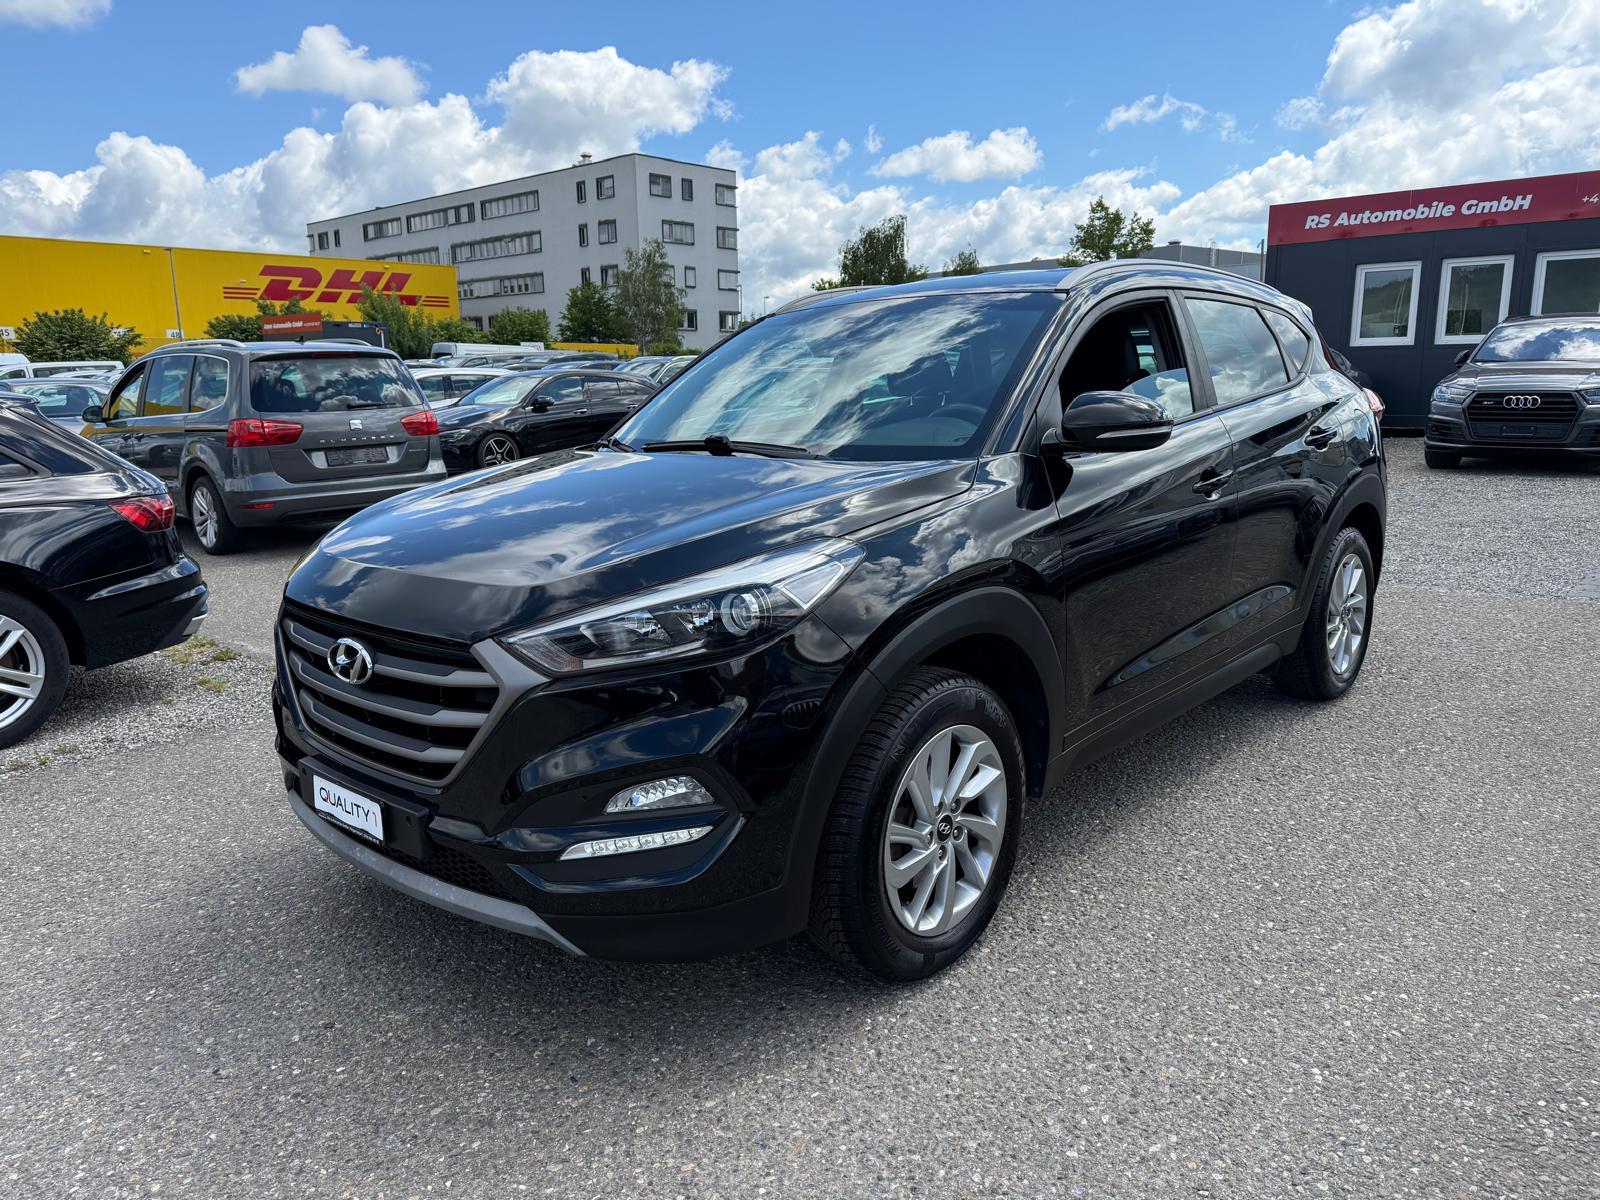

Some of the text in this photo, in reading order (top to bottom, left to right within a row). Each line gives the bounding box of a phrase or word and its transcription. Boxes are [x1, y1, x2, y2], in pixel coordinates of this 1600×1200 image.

[1304, 213, 1331, 229] RS
[1333, 200, 1456, 227] Automobile
[1461, 194, 1533, 215] GmbH
[258, 265, 422, 306] DHL
[319, 786, 370, 822] QUALITY
